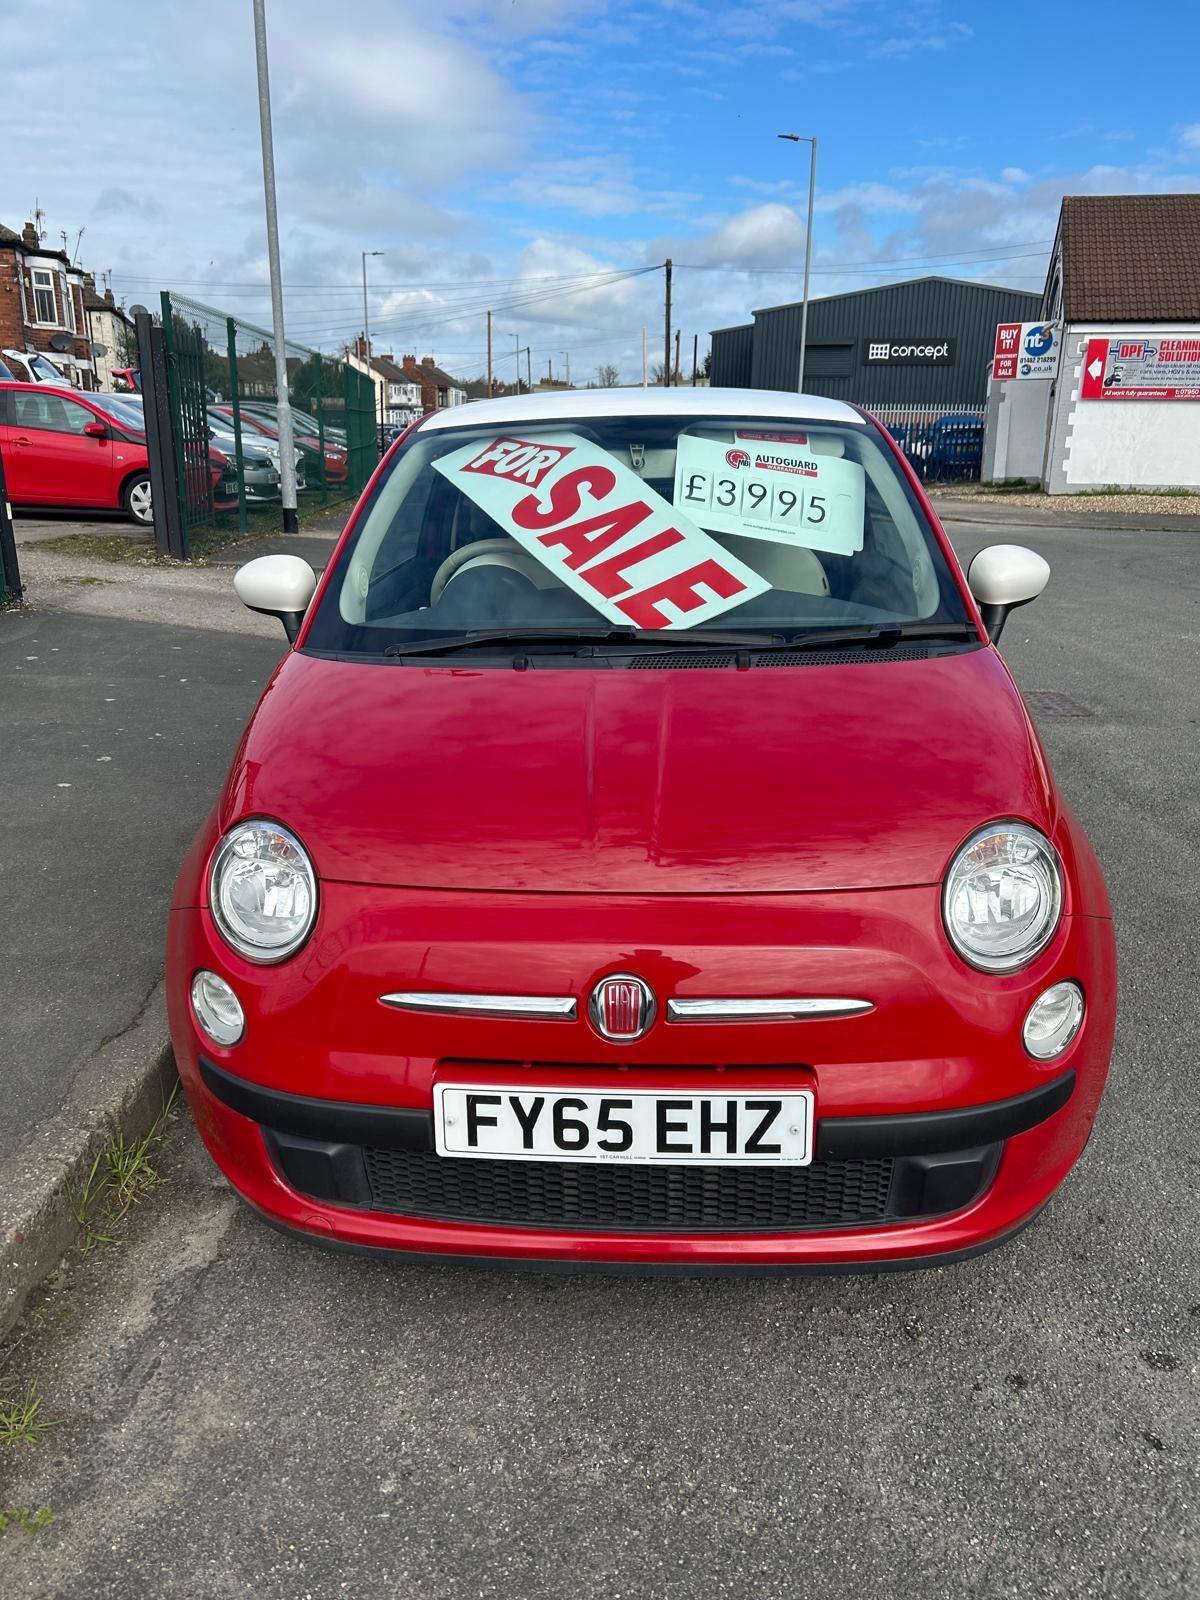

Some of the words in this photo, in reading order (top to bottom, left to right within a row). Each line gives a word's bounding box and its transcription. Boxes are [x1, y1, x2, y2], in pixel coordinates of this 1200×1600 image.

[1000, 330, 1018, 340] BUY
[891, 342, 948, 360] concept
[1002, 340, 1013, 349] IT!
[1120, 345, 1143, 357] DPF
[471, 443, 562, 483] FOR
[755, 454, 818, 471] AUTOGUARD
[767, 464, 806, 475] WARRANTIES
[685, 475, 826, 524] £3995
[511, 465, 748, 630] SALE
[609, 985, 637, 1008] FIAT
[466, 1094, 633, 1152] FY65
[656, 1099, 783, 1154] EHZ
